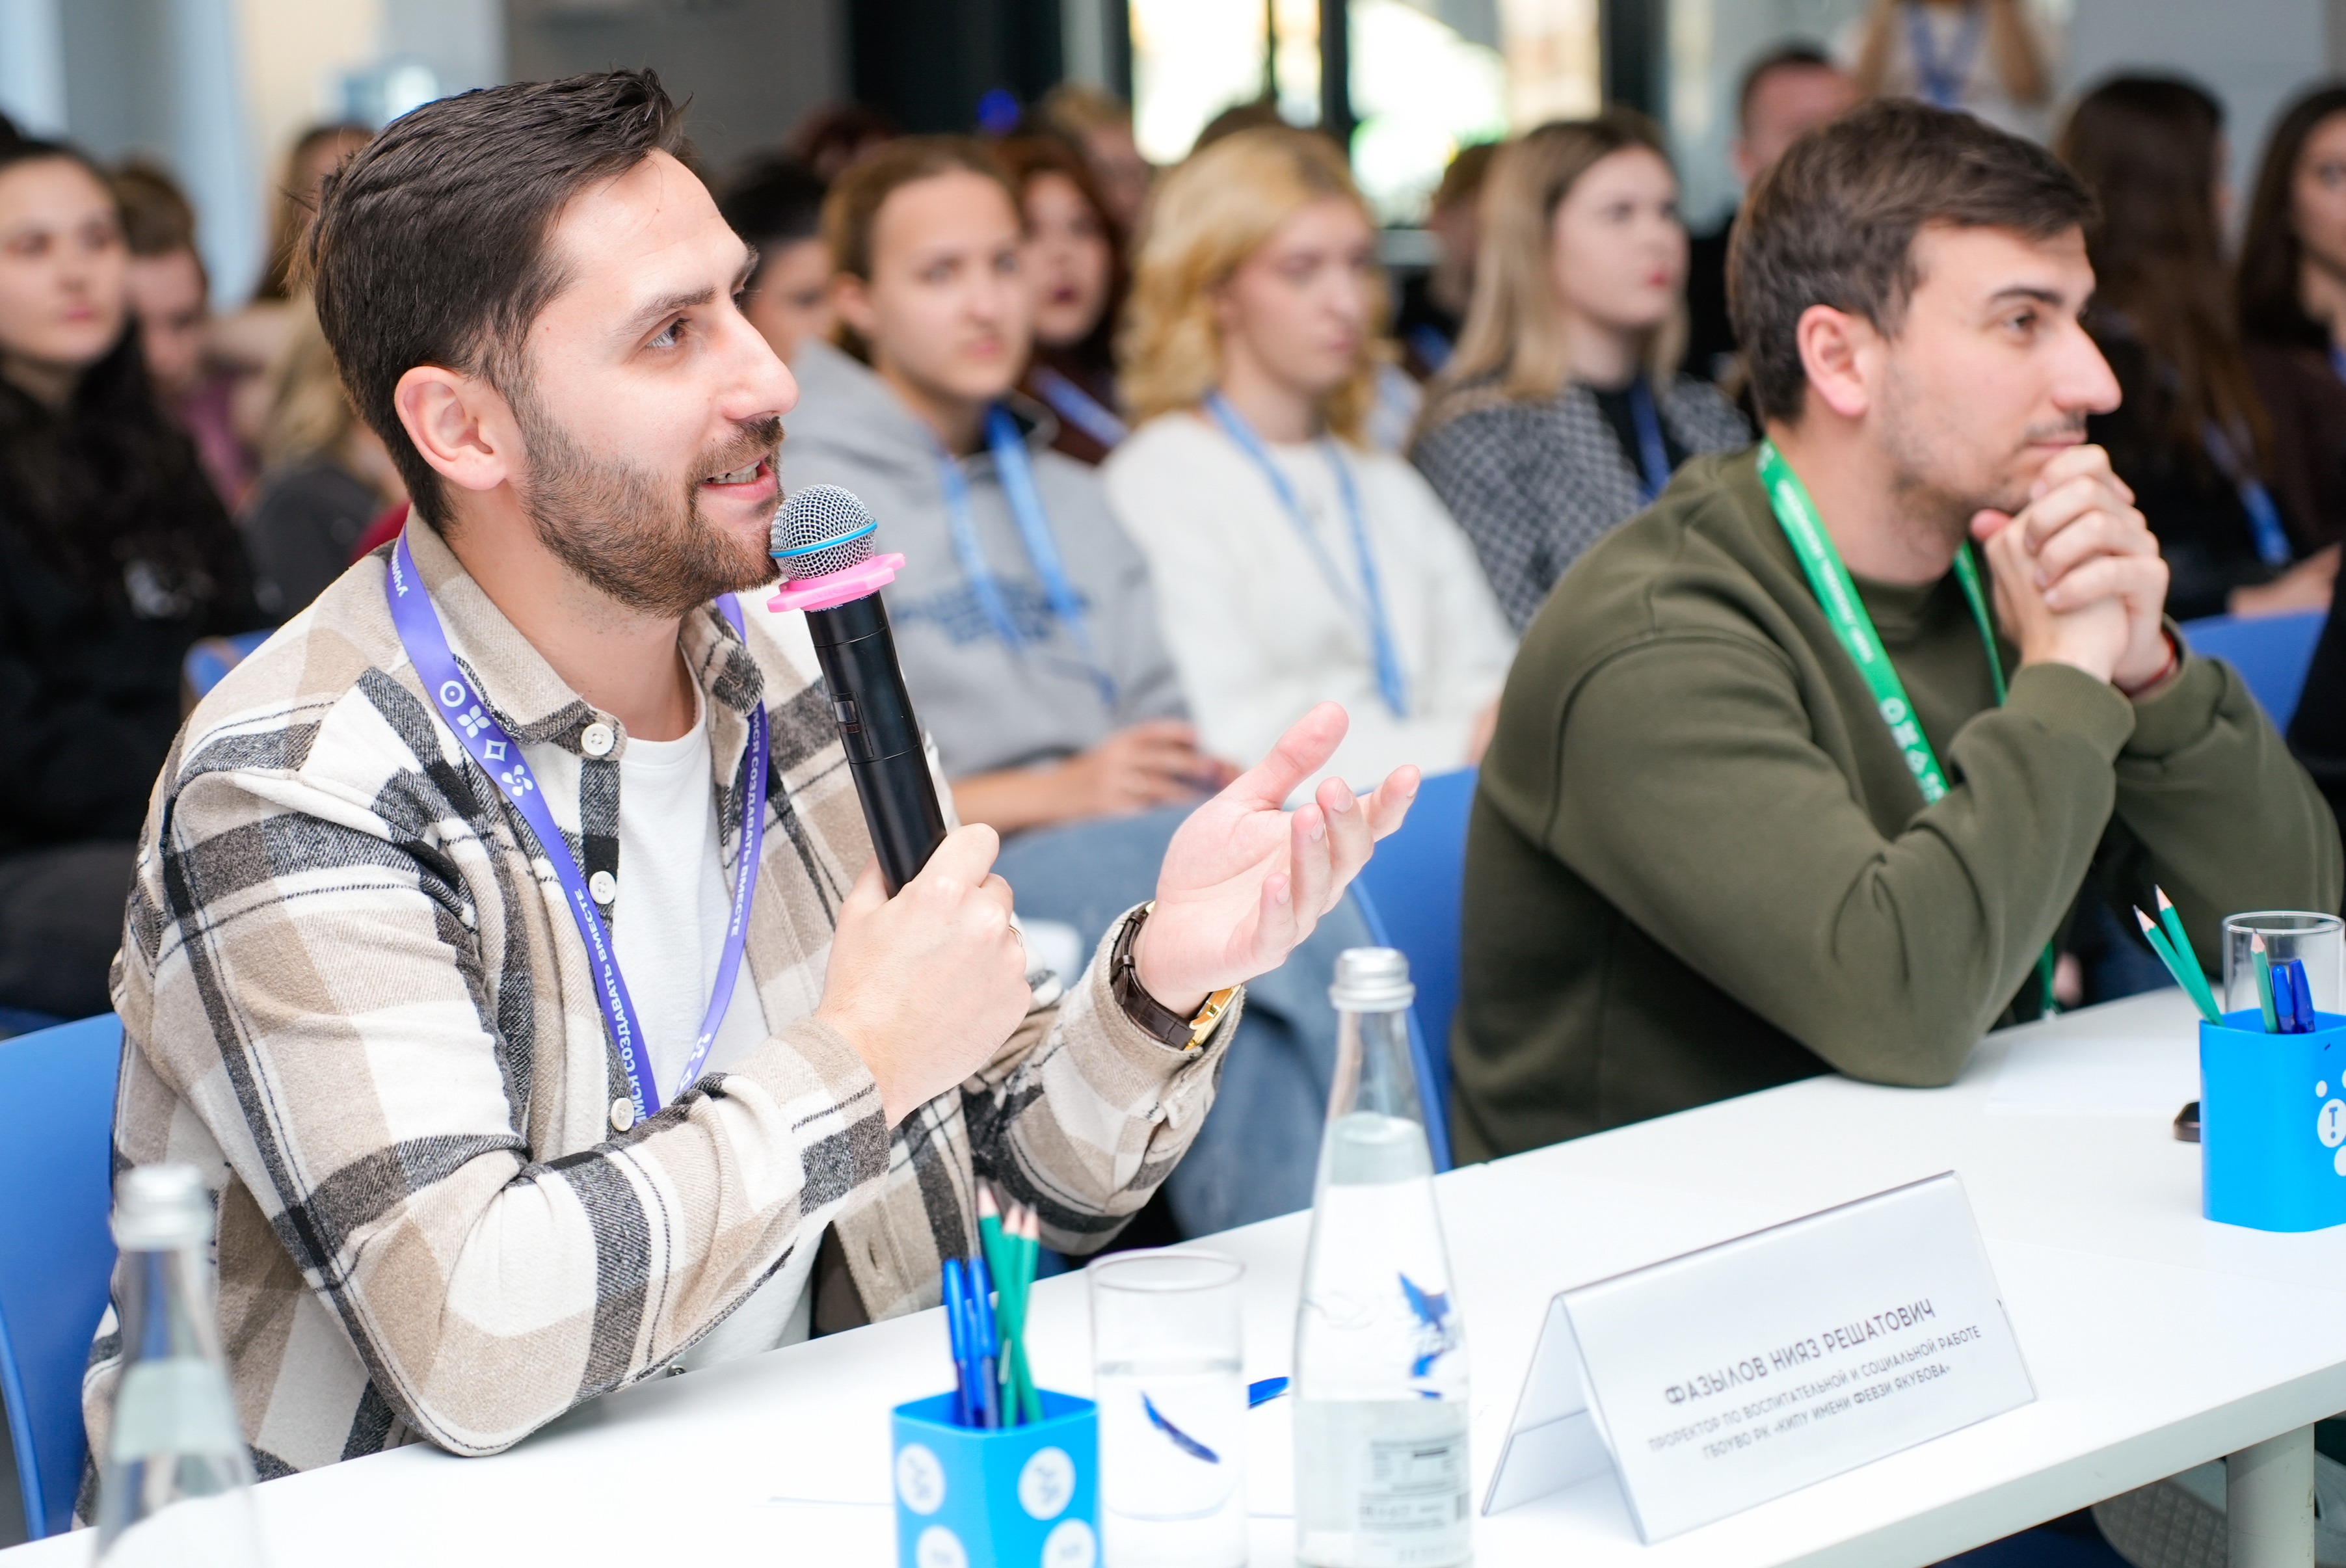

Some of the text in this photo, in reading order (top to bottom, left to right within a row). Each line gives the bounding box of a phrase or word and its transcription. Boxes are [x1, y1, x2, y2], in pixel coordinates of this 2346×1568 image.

[741, 756, 760, 864] СОЗДАВАТЬ
[574, 888, 607, 963] ВМЕСТЕ
[731, 864, 750, 937] ВМЕСТЕ
[604, 963, 636, 1073] СОЗДАВАТЬ
[1648, 1325, 1981, 1452] ПРОРЕКТОР ПО ВОСПИТАТЕЛЬНОЙ И СОЦИАЛЬНОЙ РАБОТЕ
[1665, 1298, 1936, 1406] ФАЗЫЛОВ НИЯЗ РЕШАТОВИЧ
[1702, 1432, 1752, 1459] ГБОУВО
[1753, 1426, 1771, 1441] РК
[1811, 1396, 1852, 1420] ИМЕНИ
[1854, 1381, 1893, 1405] ФЕВЗИ
[1895, 1363, 1951, 1391] ЯКУБОВА»
